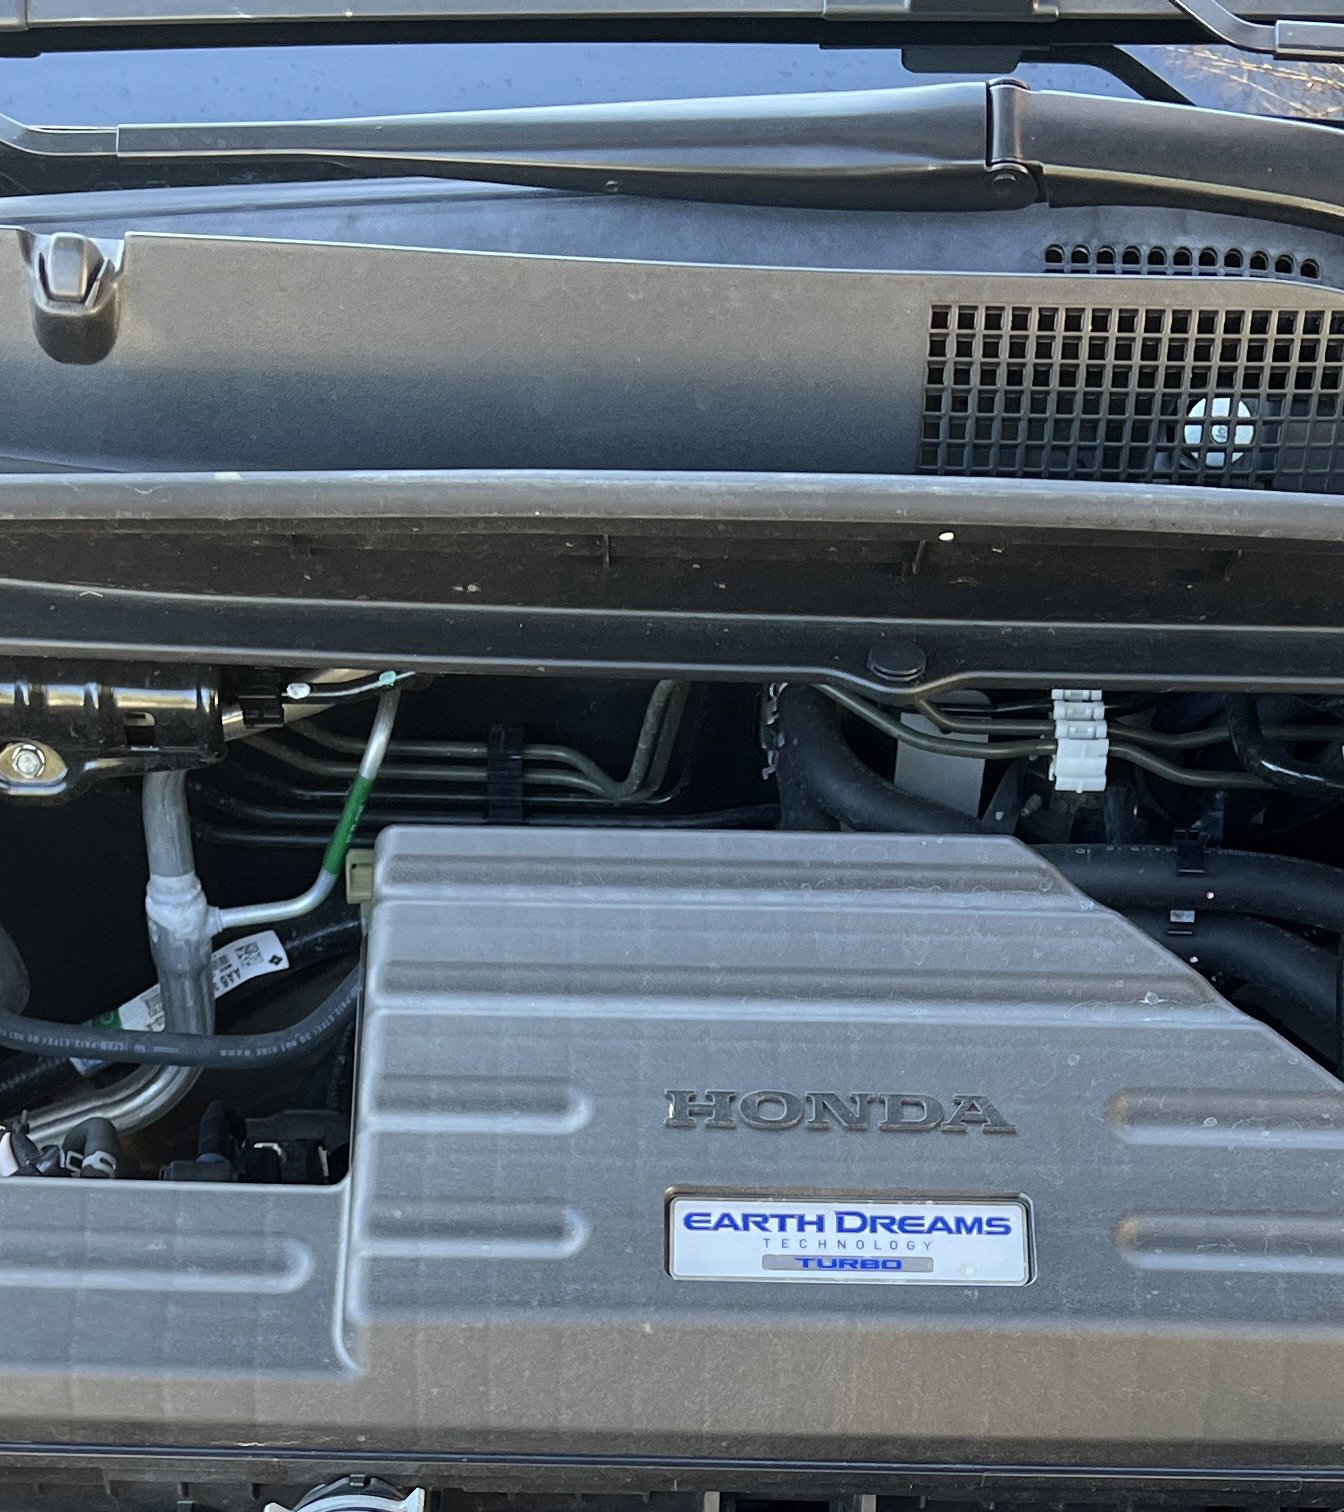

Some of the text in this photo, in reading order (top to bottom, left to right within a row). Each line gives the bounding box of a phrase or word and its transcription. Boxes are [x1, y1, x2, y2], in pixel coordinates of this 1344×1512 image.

[664, 1089, 1018, 1134] HONDA
[683, 1210, 1012, 1236] EARTH DREAMS
[763, 1238, 933, 1251] TECHNOLOGY
[794, 1256, 903, 1271] TURBO
